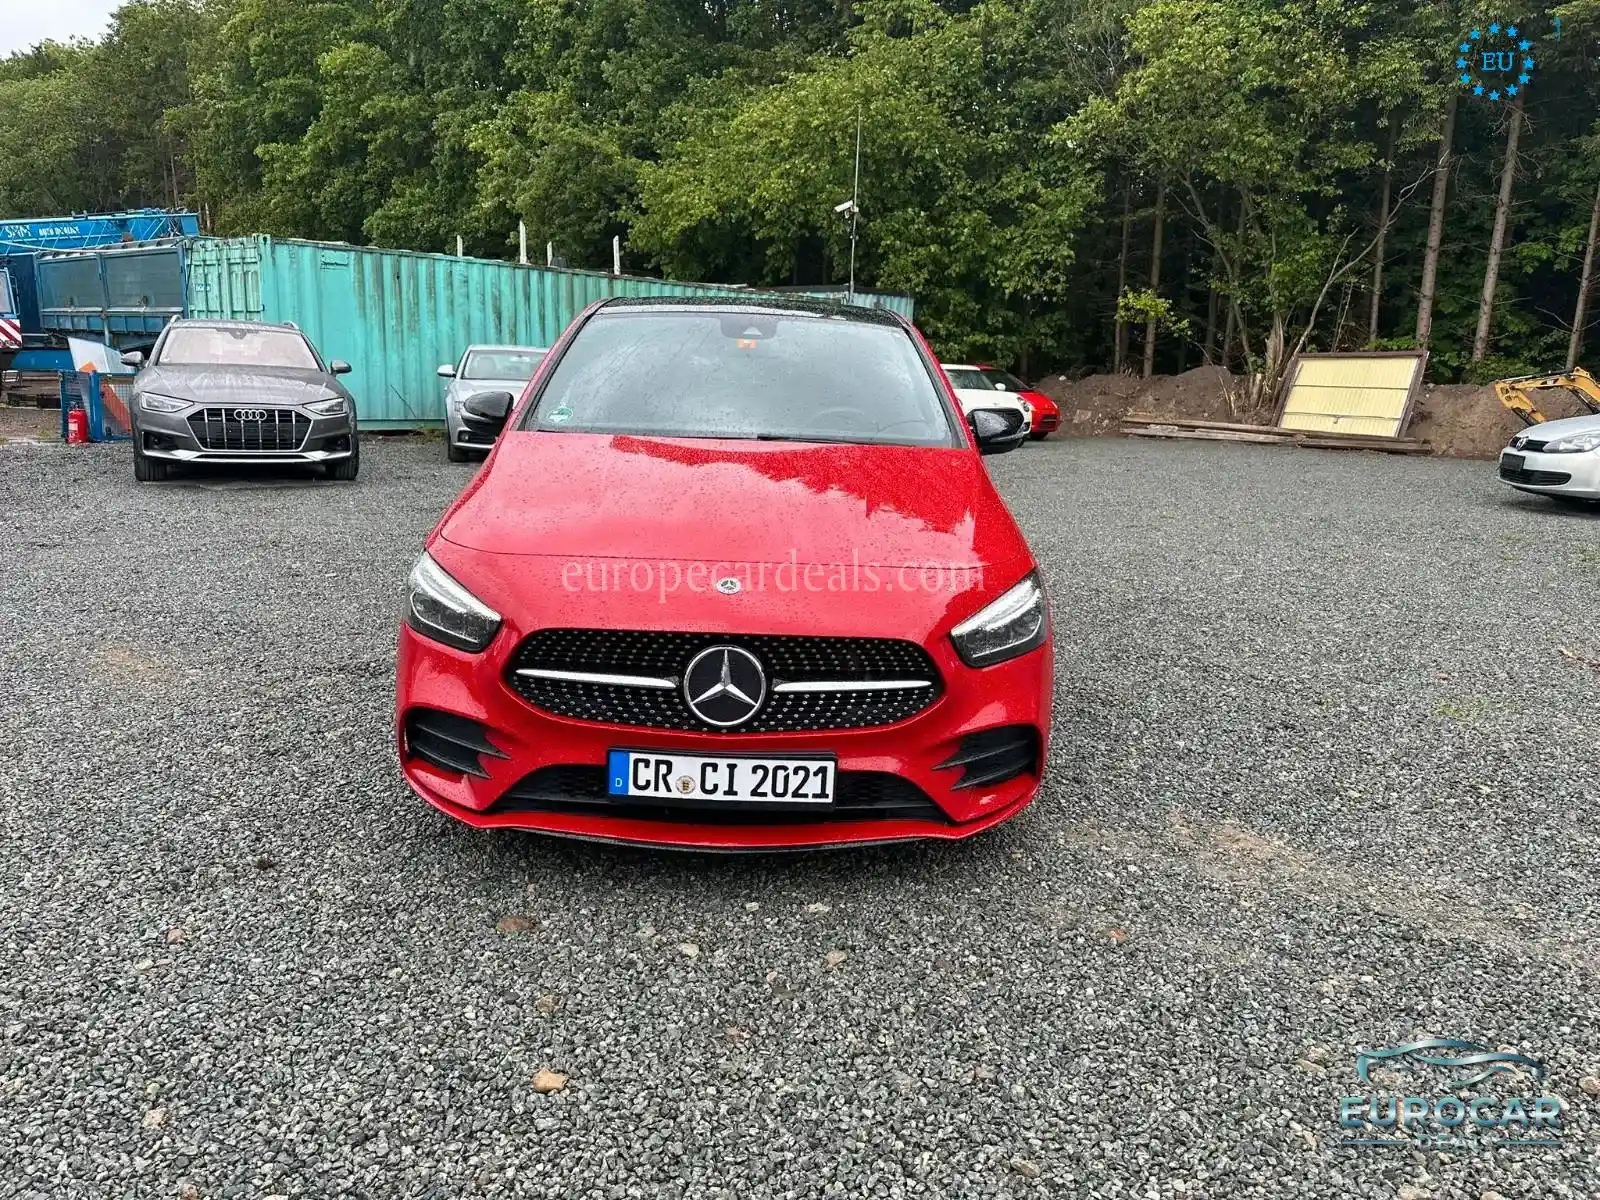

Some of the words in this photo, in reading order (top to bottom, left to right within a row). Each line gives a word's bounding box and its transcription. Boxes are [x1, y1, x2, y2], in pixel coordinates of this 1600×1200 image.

[614, 777, 623, 788] D
[632, 757, 673, 793] CR
[699, 762, 738, 796] CI
[749, 763, 830, 800] 2021
